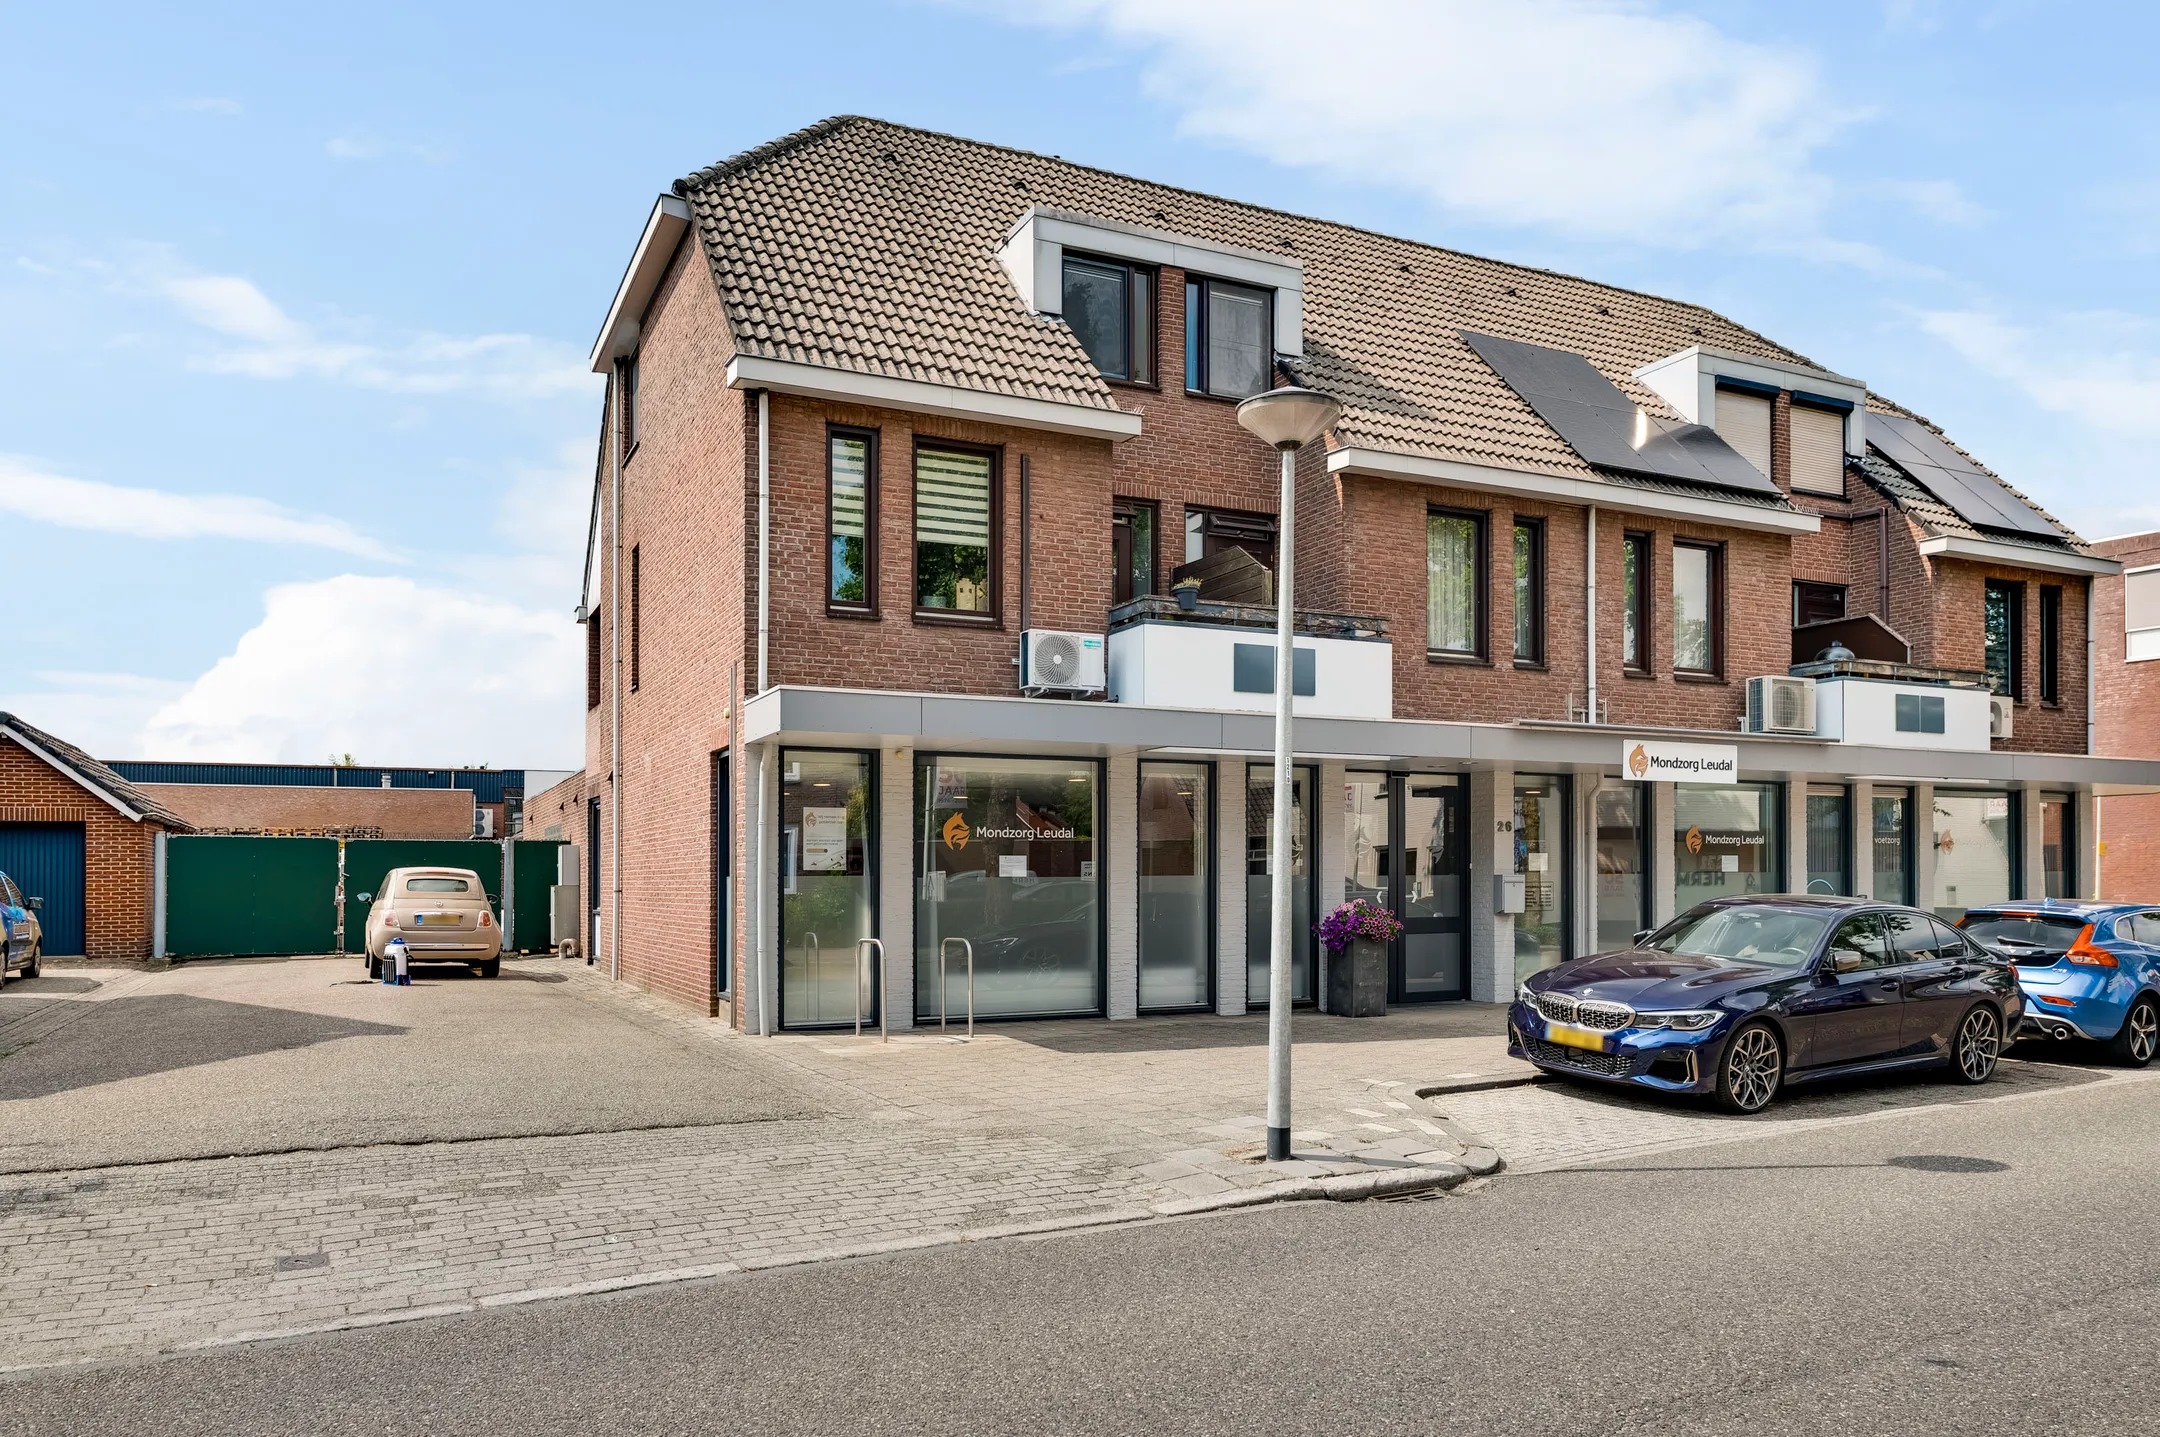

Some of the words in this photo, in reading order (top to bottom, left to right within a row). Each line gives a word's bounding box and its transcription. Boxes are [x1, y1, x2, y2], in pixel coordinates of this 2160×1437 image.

[1650, 755, 1699, 772] Mondzorg
[1700, 758, 1733, 771] Leudal
[1497, 821, 1512, 832] 26
[976, 826, 1035, 841] Mondzorg
[1037, 827, 1074, 839] Leudal
[1705, 835, 1740, 846] Mondzorg
[1741, 836, 1764, 845] Leudal
[1874, 836, 1900, 846] voetzorg
